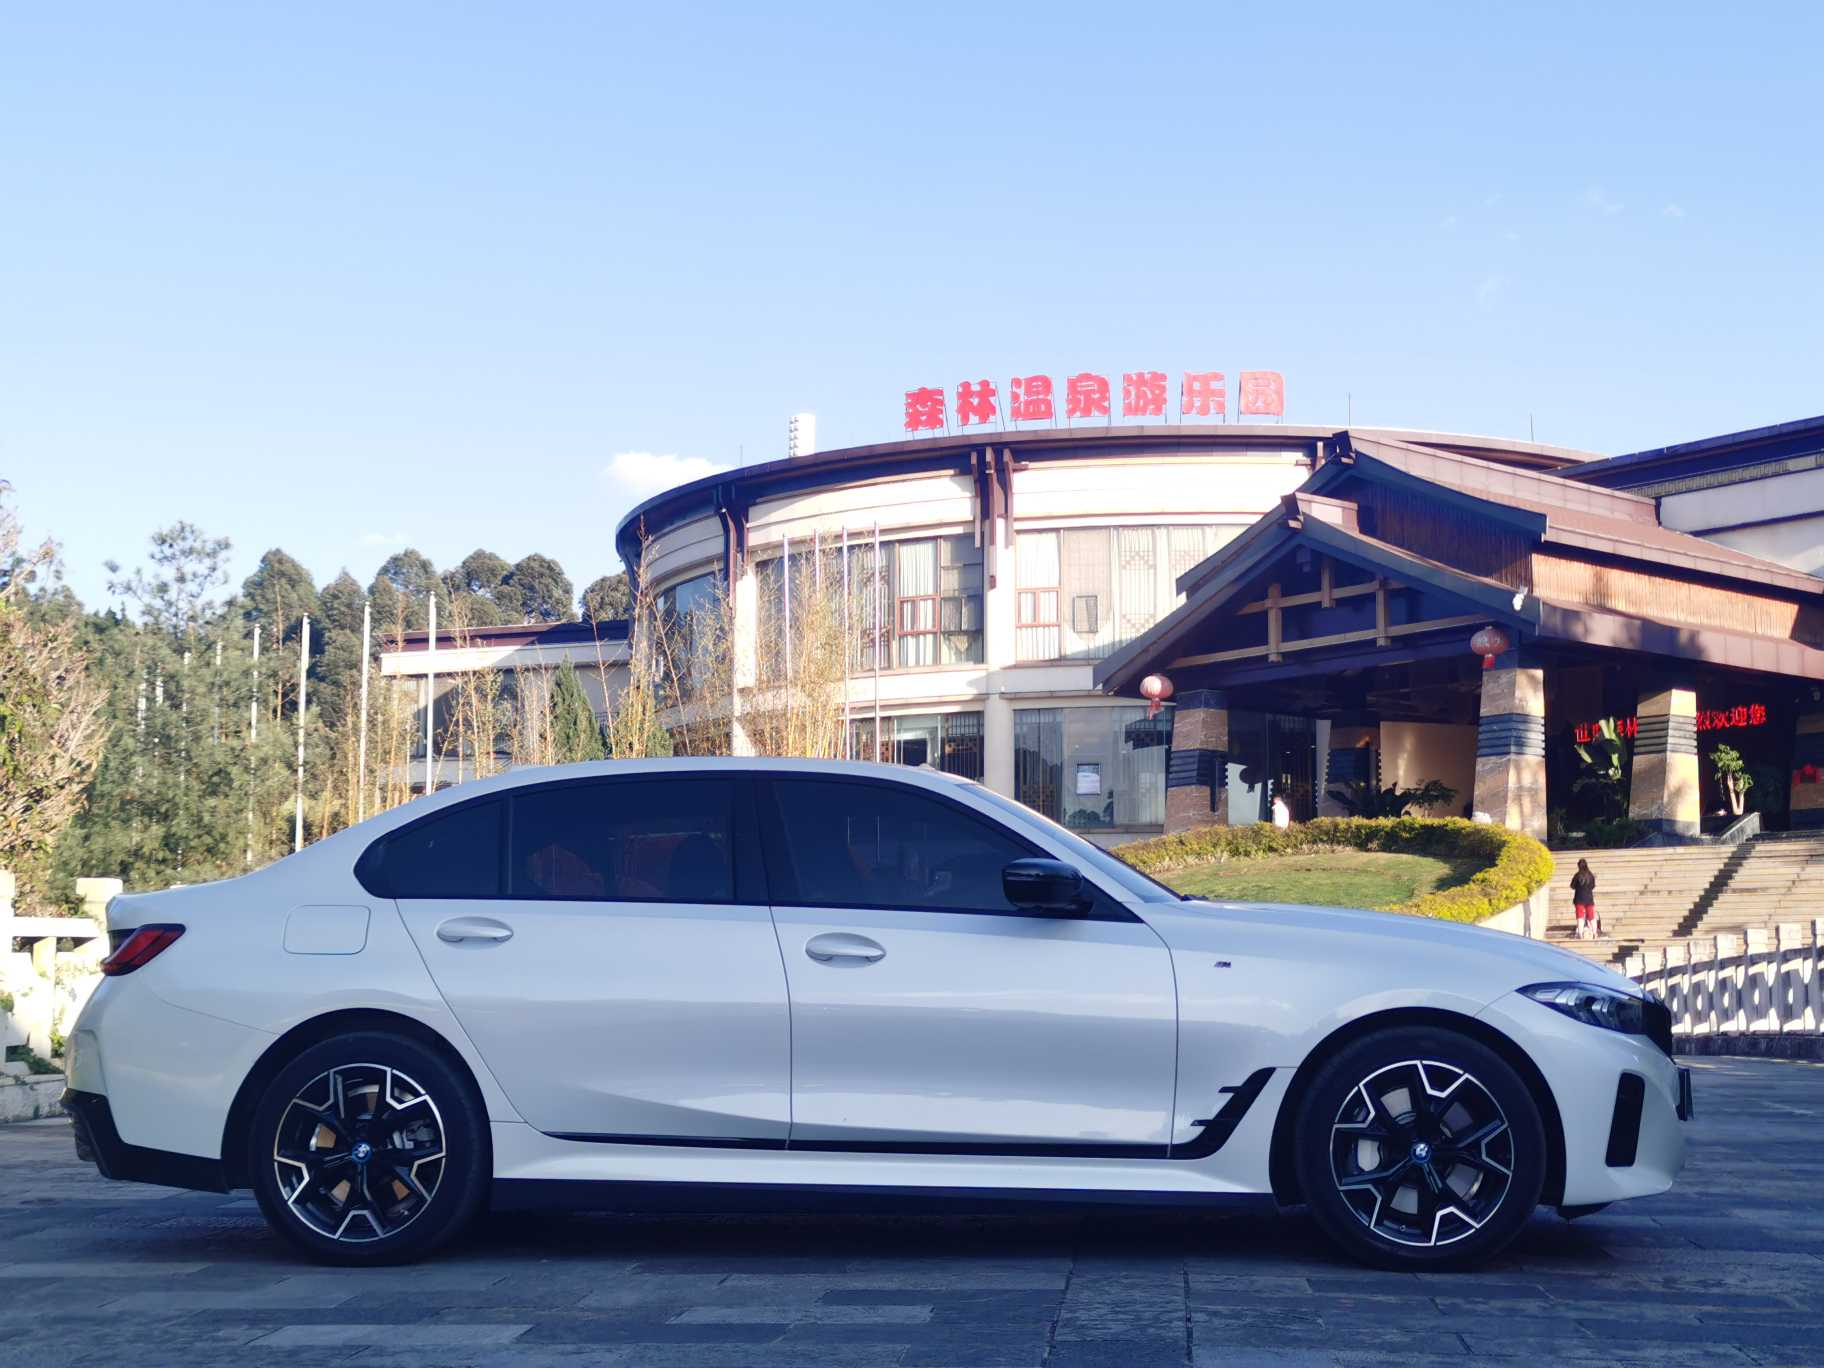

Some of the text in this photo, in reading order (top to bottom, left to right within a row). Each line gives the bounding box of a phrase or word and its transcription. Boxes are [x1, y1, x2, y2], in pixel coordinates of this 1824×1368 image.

[904, 370, 1284, 430] 森林温泉游乐园
